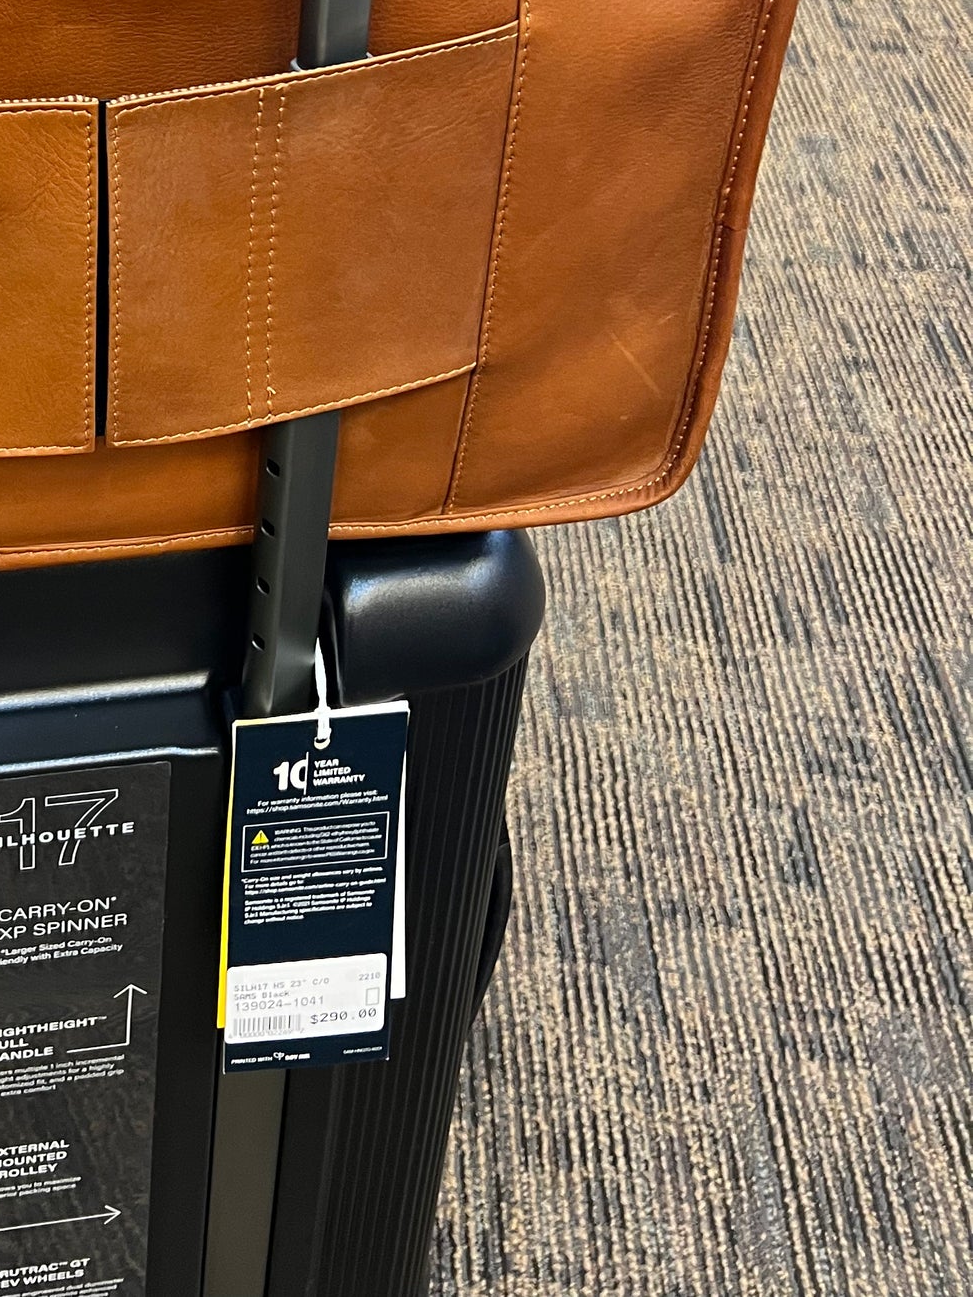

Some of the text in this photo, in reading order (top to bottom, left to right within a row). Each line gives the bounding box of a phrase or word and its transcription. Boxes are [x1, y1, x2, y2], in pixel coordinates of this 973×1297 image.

[314, 759, 339, 768] YEAR
[313, 766, 351, 777] LIMITED
[312, 774, 366, 786] WARRANTY
[271, 797, 300, 806] warranty
[301, 794, 339, 802] information
[340, 792, 362, 800] please
[33, 913, 127, 937] SPINNER
[39, 941, 65, 951] Sized
[67, 936, 112, 949] Carry-On
[30, 952, 51, 962] with
[53, 949, 79, 959] Extra
[80, 943, 123, 955] Capacity
[234, 983, 268, 992] SILH17
[359, 972, 381, 981] 2210
[234, 991, 290, 1001] SAMS Black
[235, 996, 324, 1012] 139024-1041
[310, 1008, 377, 1025] $290.00
[14, 1065, 48, 1074] multiple
[75, 1054, 125, 1066] incremental
[15, 1069, 67, 1081] adjustments
[49, 1076, 65, 1084] and
[74, 1071, 106, 1081] padded
[107, 1069, 124, 1077] grip
[23, 1084, 56, 1094] comfort
[19, 1187, 50, 1197] packing
[52, 1183, 77, 1192] space
[70, 1258, 91, 1268] GT
[23, 1269, 84, 1285] WHEELS
